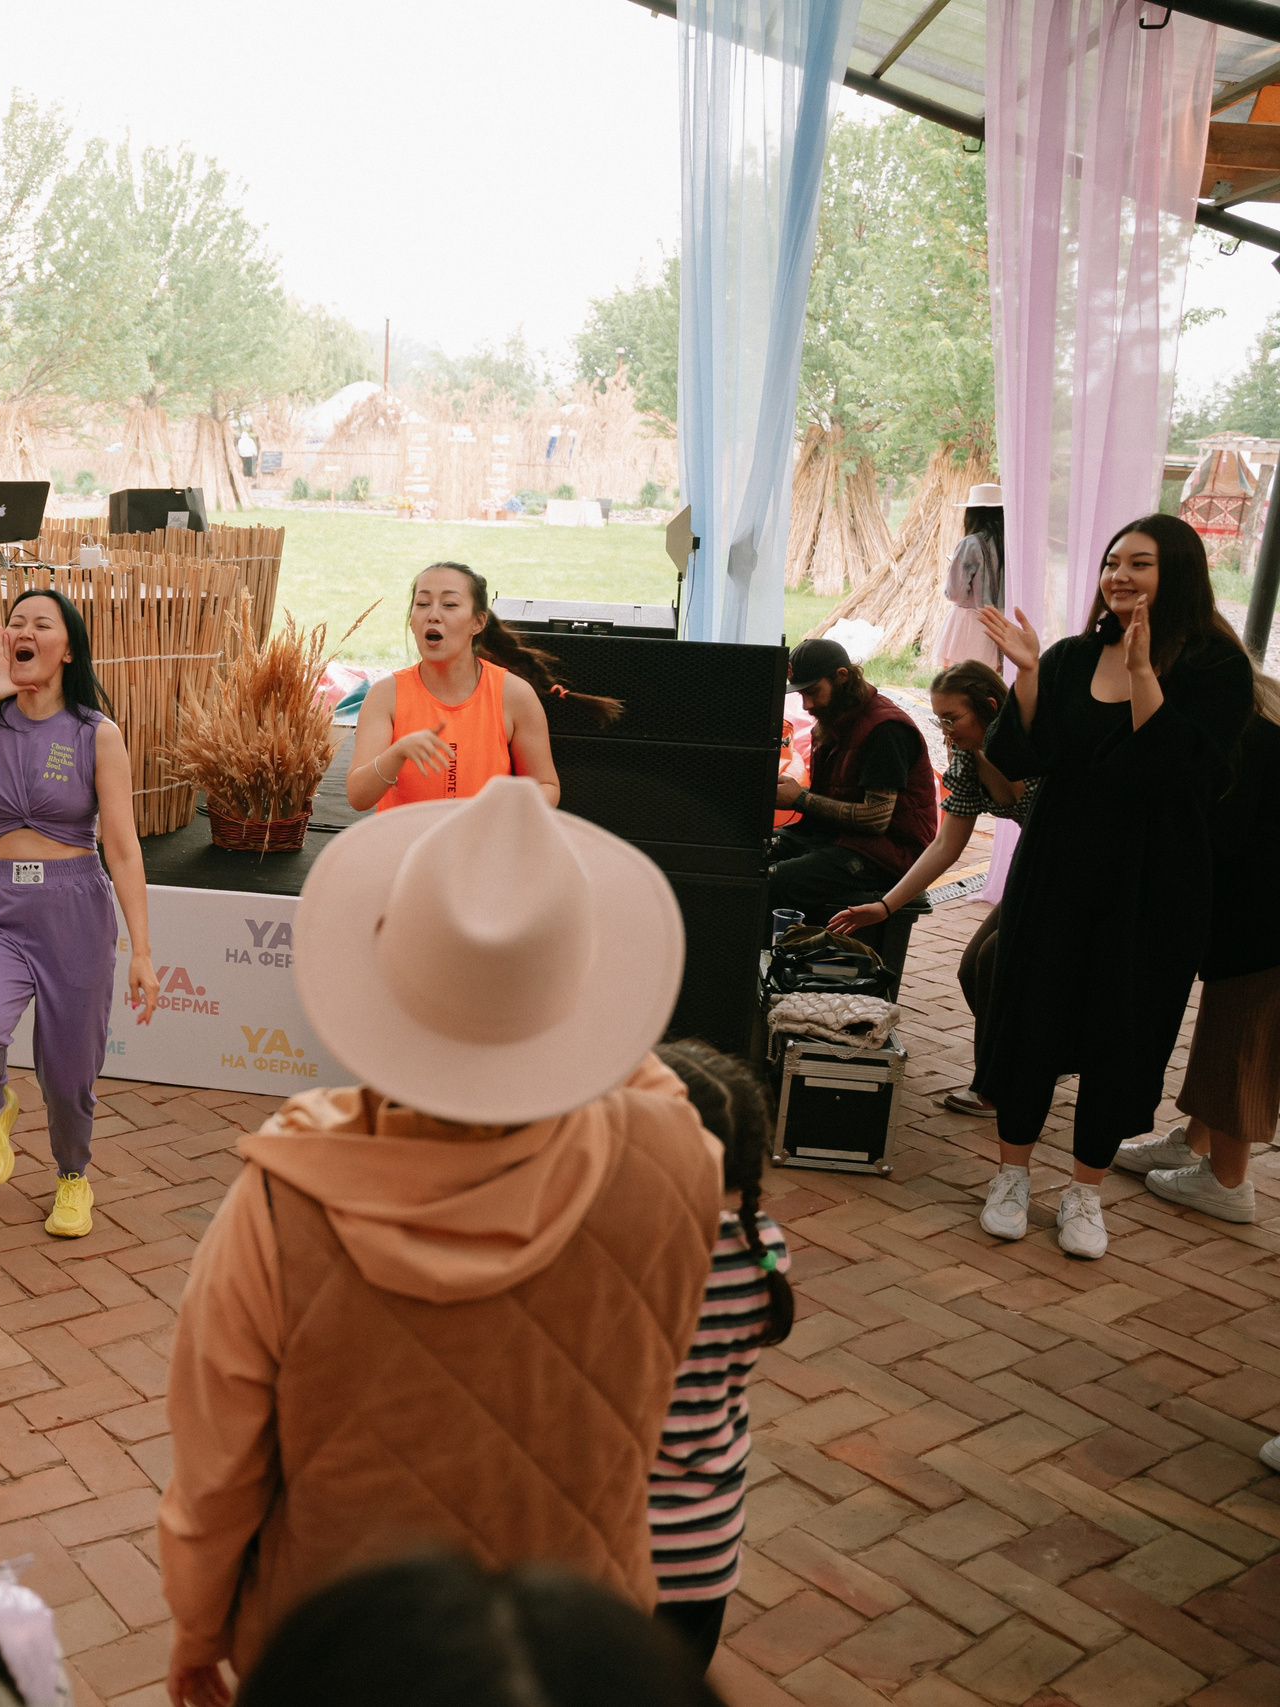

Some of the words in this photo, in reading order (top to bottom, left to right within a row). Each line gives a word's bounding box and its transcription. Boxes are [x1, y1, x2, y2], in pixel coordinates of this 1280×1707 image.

[245, 919, 293, 950] YA
[226, 948, 251, 964] НА
[258, 951, 293, 968] ФЕР
[156, 996, 219, 1015] ФЕРМЕ
[240, 1026, 305, 1058] YA.
[222, 1054, 246, 1070] НА
[253, 1057, 318, 1078] ФЕРМЕ
